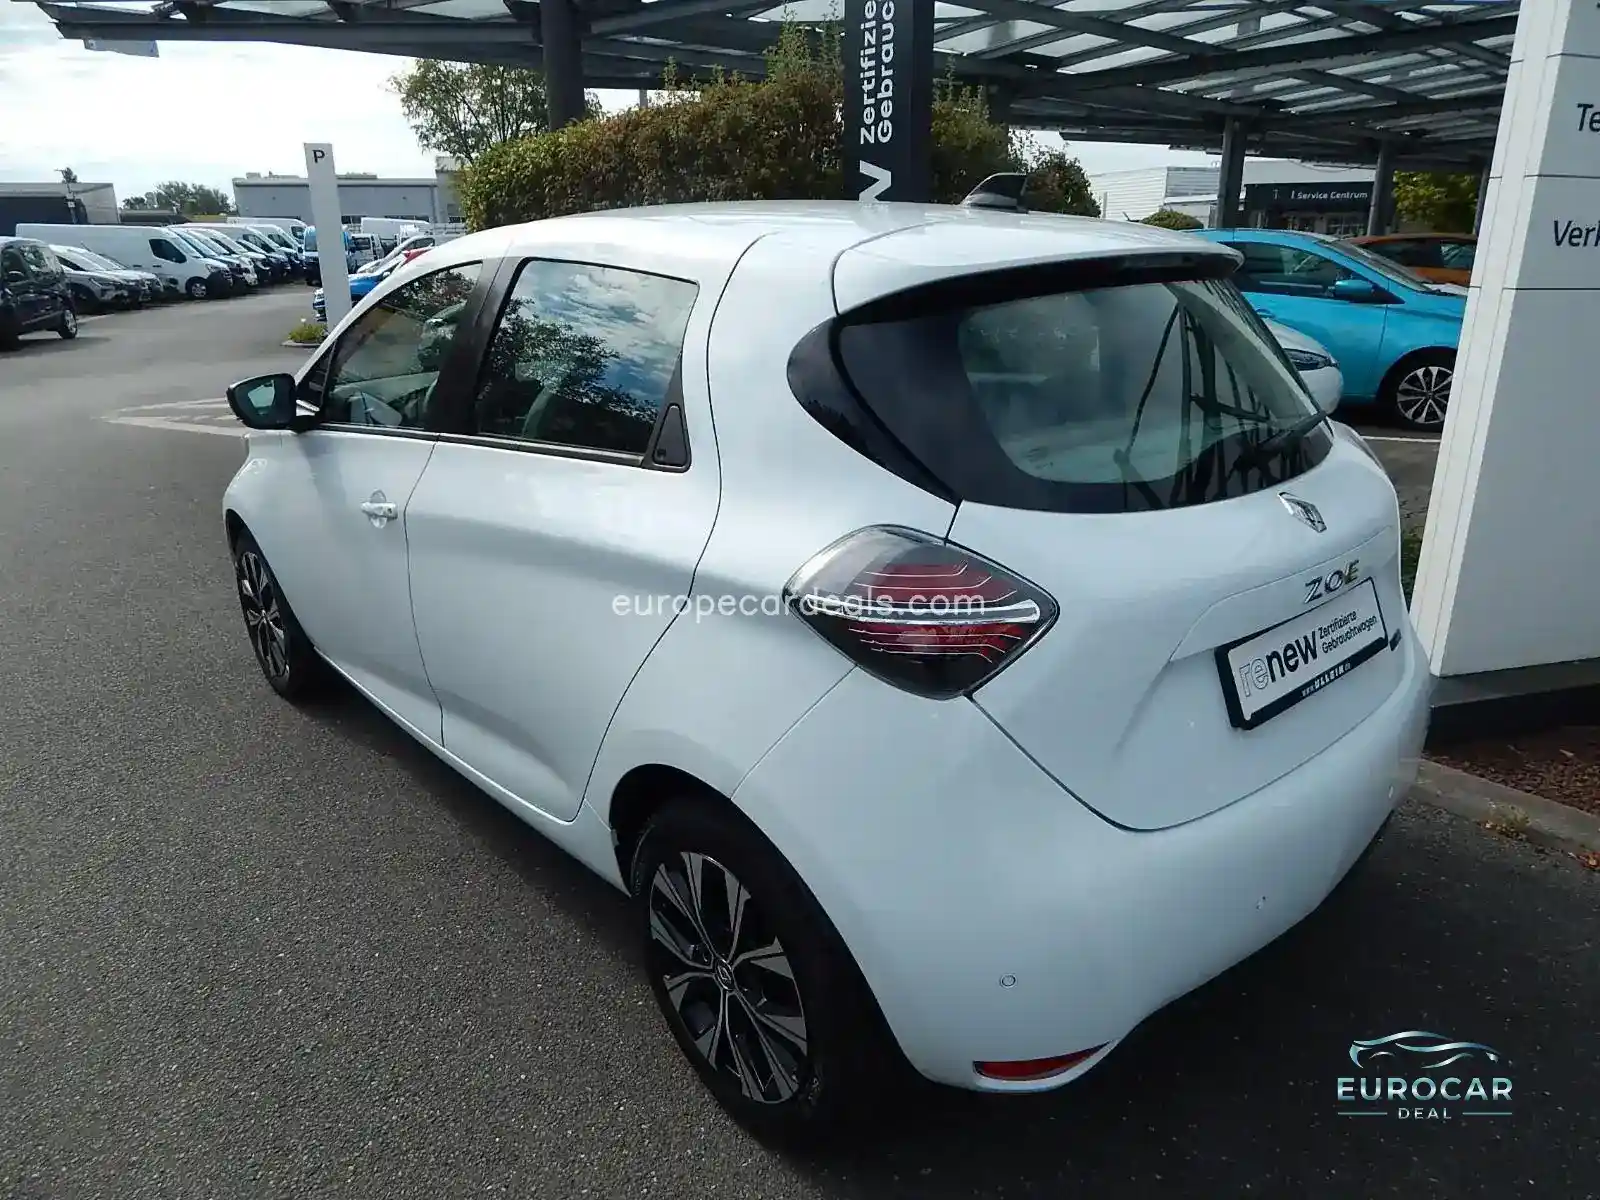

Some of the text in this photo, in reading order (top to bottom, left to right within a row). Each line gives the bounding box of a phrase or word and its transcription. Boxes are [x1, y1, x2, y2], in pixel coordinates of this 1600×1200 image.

[312, 149, 325, 164] P
[1297, 191, 1368, 199] Service Centrum
[1239, 631, 1318, 698] renew
